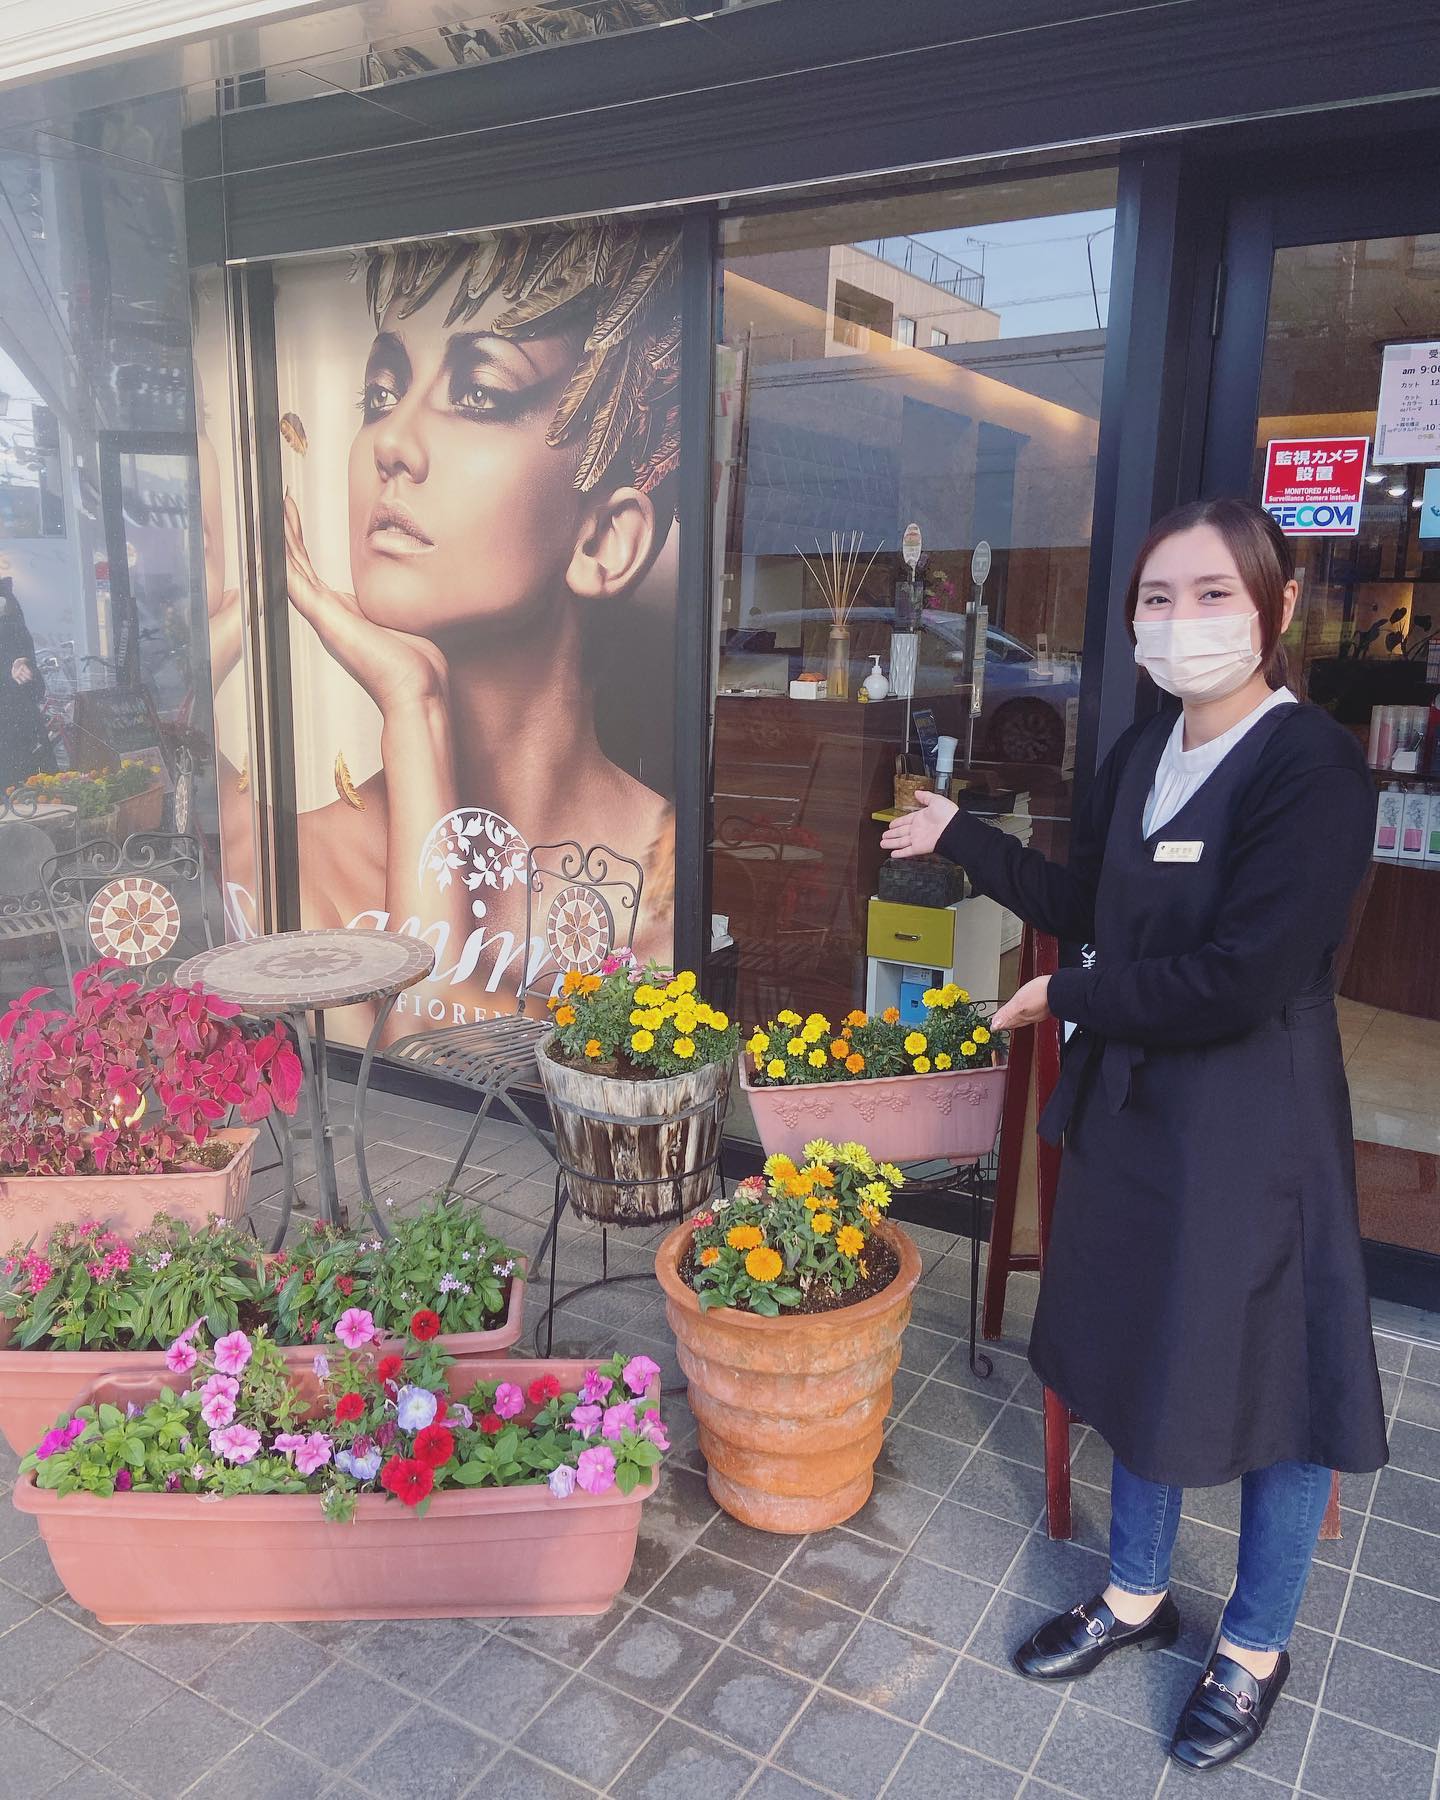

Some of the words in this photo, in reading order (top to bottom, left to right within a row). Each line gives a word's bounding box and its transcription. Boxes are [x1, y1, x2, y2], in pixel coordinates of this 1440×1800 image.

[1428, 349, 1440, 359] 受
[1275, 449, 1359, 466] 監視カメラ
[1296, 466, 1333, 482] 設置
[1284, 487, 1322, 495] MONITORED
[1323, 486, 1341, 494] AREA
[1268, 505, 1354, 527] SECOM
